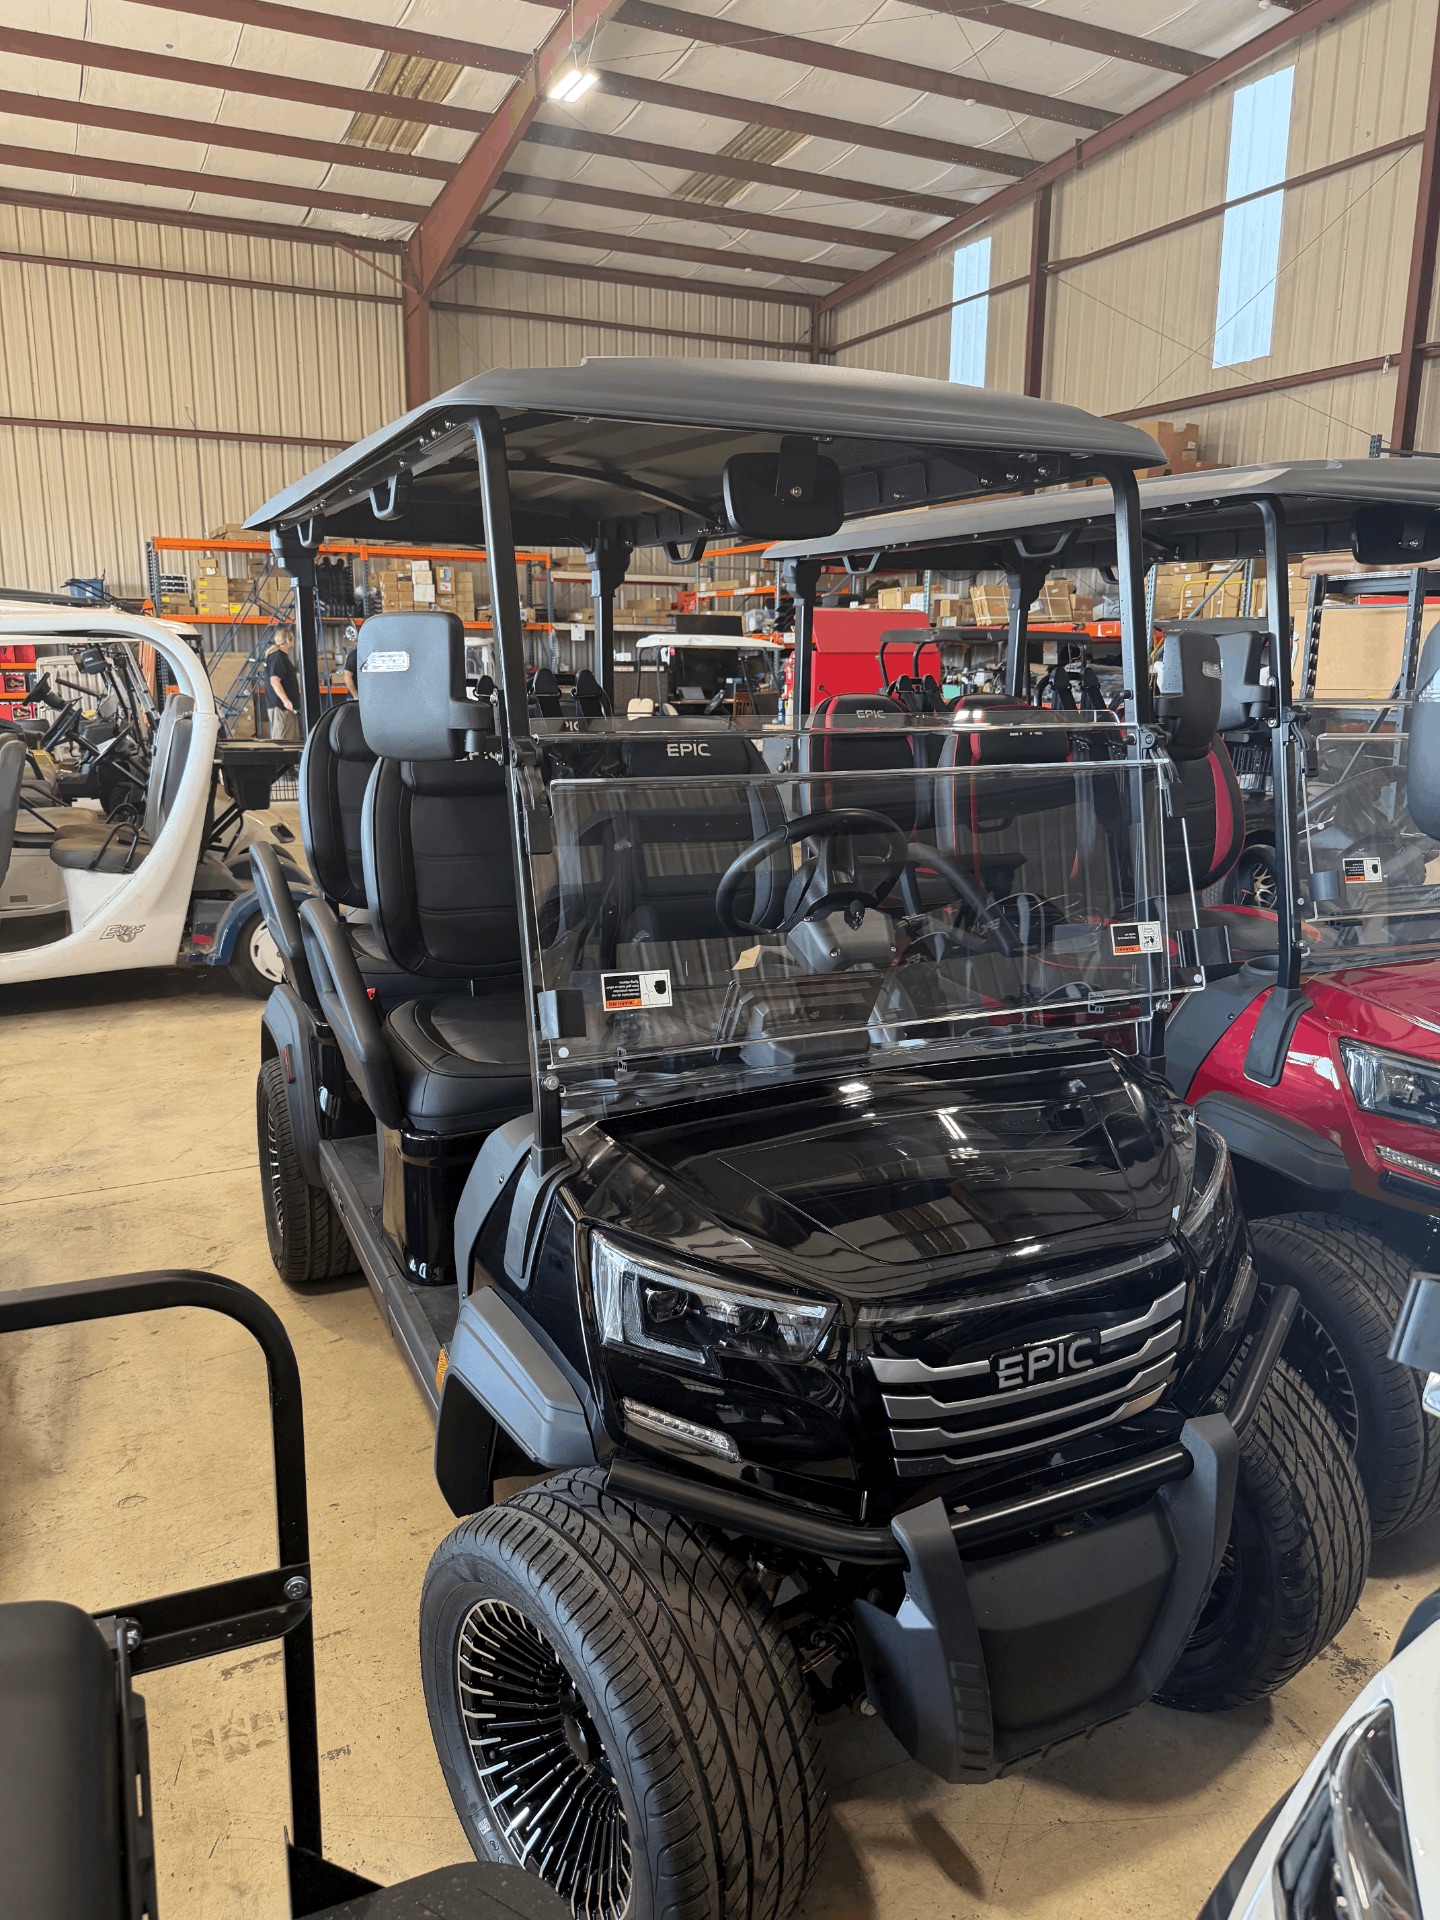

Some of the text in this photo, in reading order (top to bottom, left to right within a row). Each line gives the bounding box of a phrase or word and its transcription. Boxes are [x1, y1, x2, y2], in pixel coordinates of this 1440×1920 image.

[856, 709, 886, 719] EPIC
[666, 743, 712, 757] EPIC
[995, 1337, 1094, 1390] EPIC
